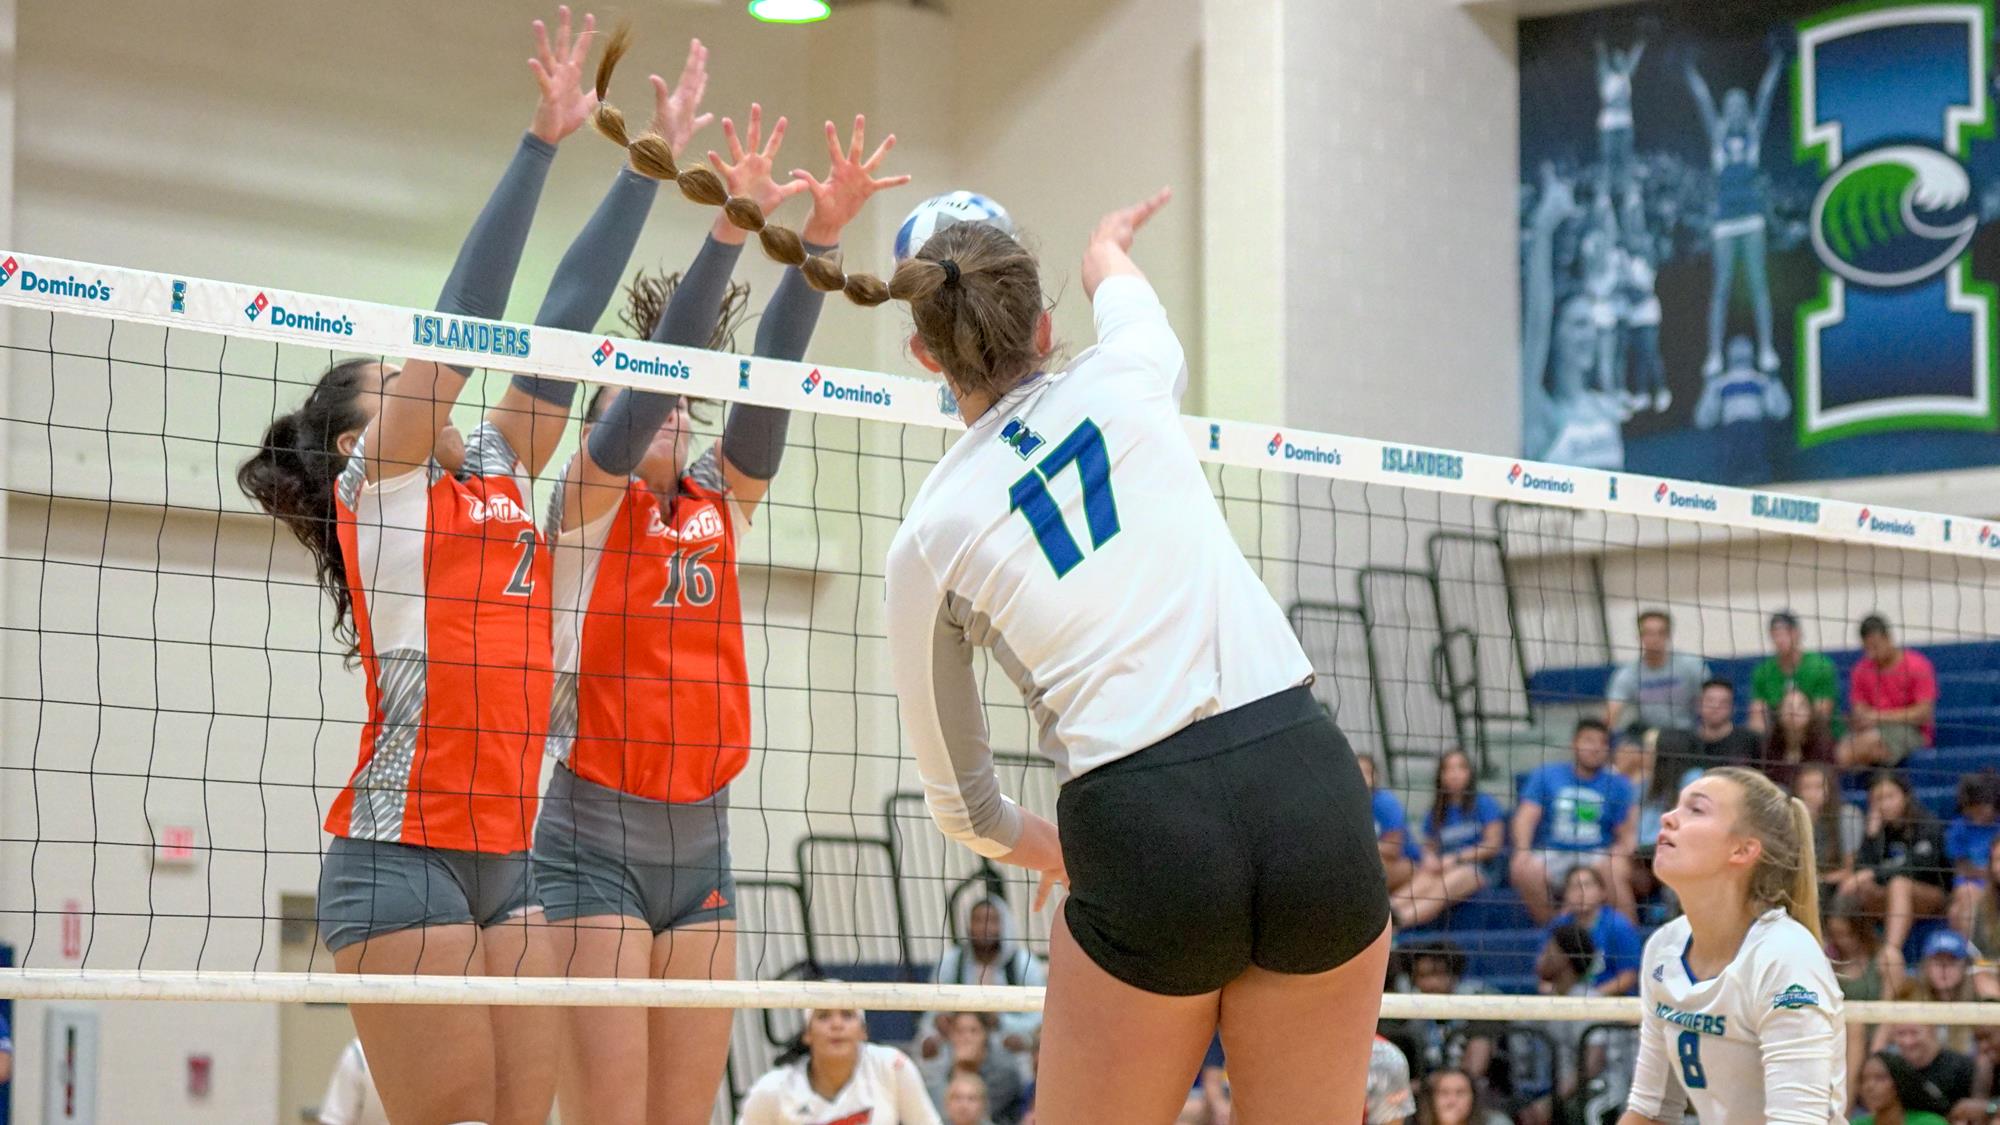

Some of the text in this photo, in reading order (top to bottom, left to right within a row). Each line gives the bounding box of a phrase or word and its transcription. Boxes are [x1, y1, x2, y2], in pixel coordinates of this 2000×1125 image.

[20, 270, 112, 301] Domino's
[270, 306, 354, 336] Domino's
[413, 314, 531, 358] ISLANDERS
[615, 352, 690, 380] Domino's
[823, 381, 891, 406] Domino's
[1285, 444, 1341, 465] Domino's
[1382, 446, 1464, 480] ISLANDERS
[1008, 416, 1121, 581] 17
[1522, 473, 1574, 494] Domino's
[1670, 491, 1717, 511] Domino's
[1751, 494, 1820, 524] ISLANDERS
[502, 530, 536, 596] 2
[652, 543, 719, 607] 16
[1677, 1030, 1708, 1089] 8
